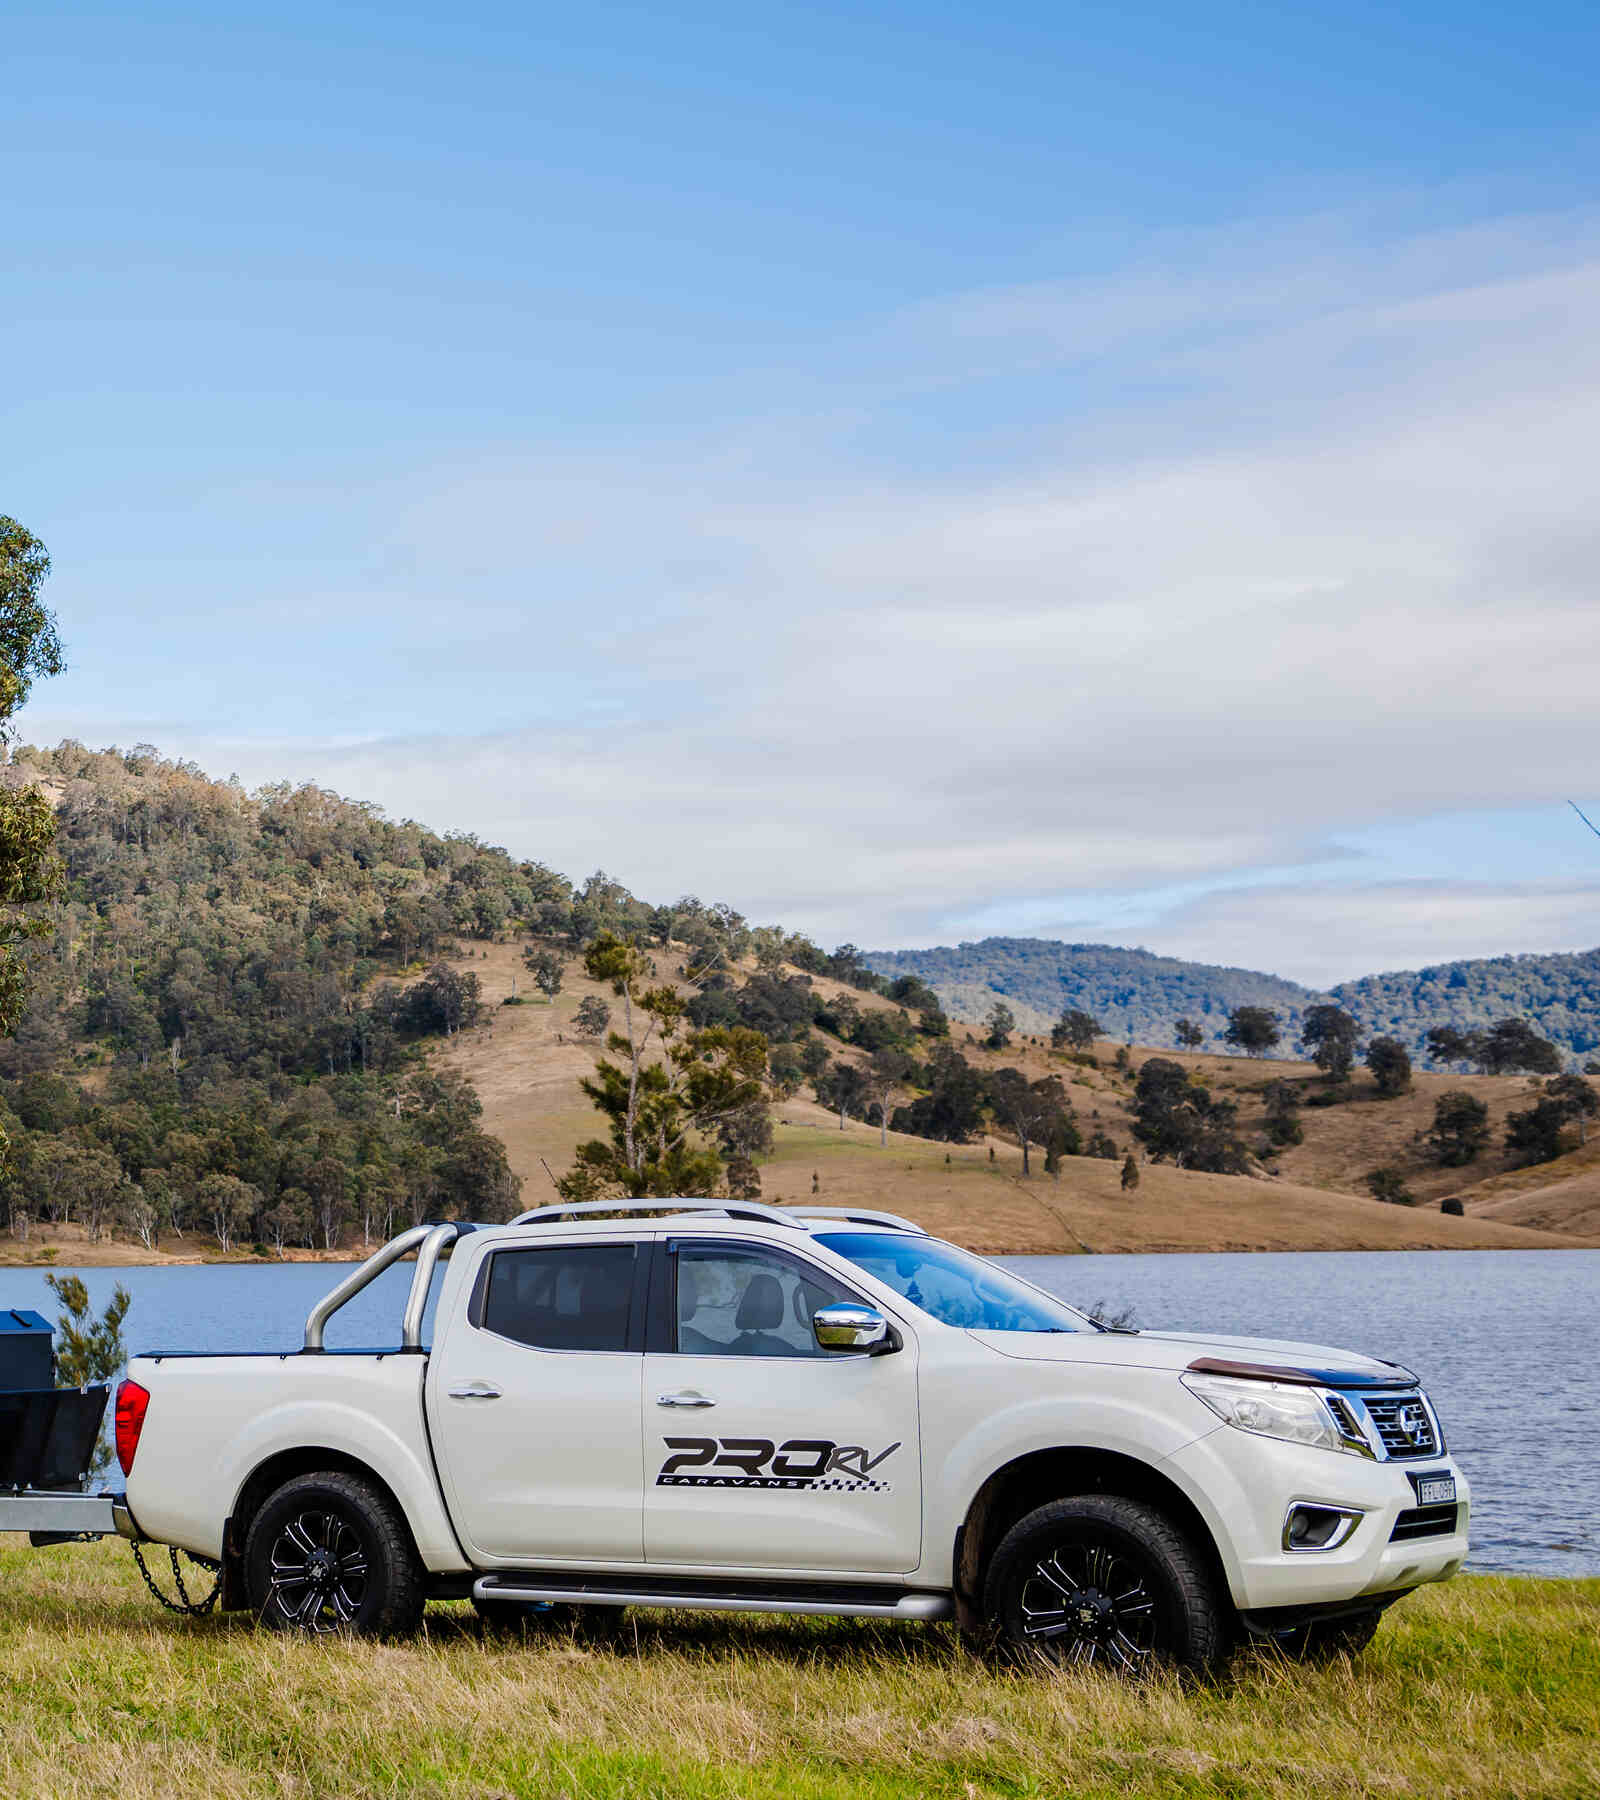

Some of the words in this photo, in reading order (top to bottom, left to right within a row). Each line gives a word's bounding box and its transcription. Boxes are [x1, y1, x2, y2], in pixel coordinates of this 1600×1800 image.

[659, 1437, 838, 1477] PRO
[826, 1442, 901, 1481] RV
[662, 1477, 798, 1487] CARAVANS
